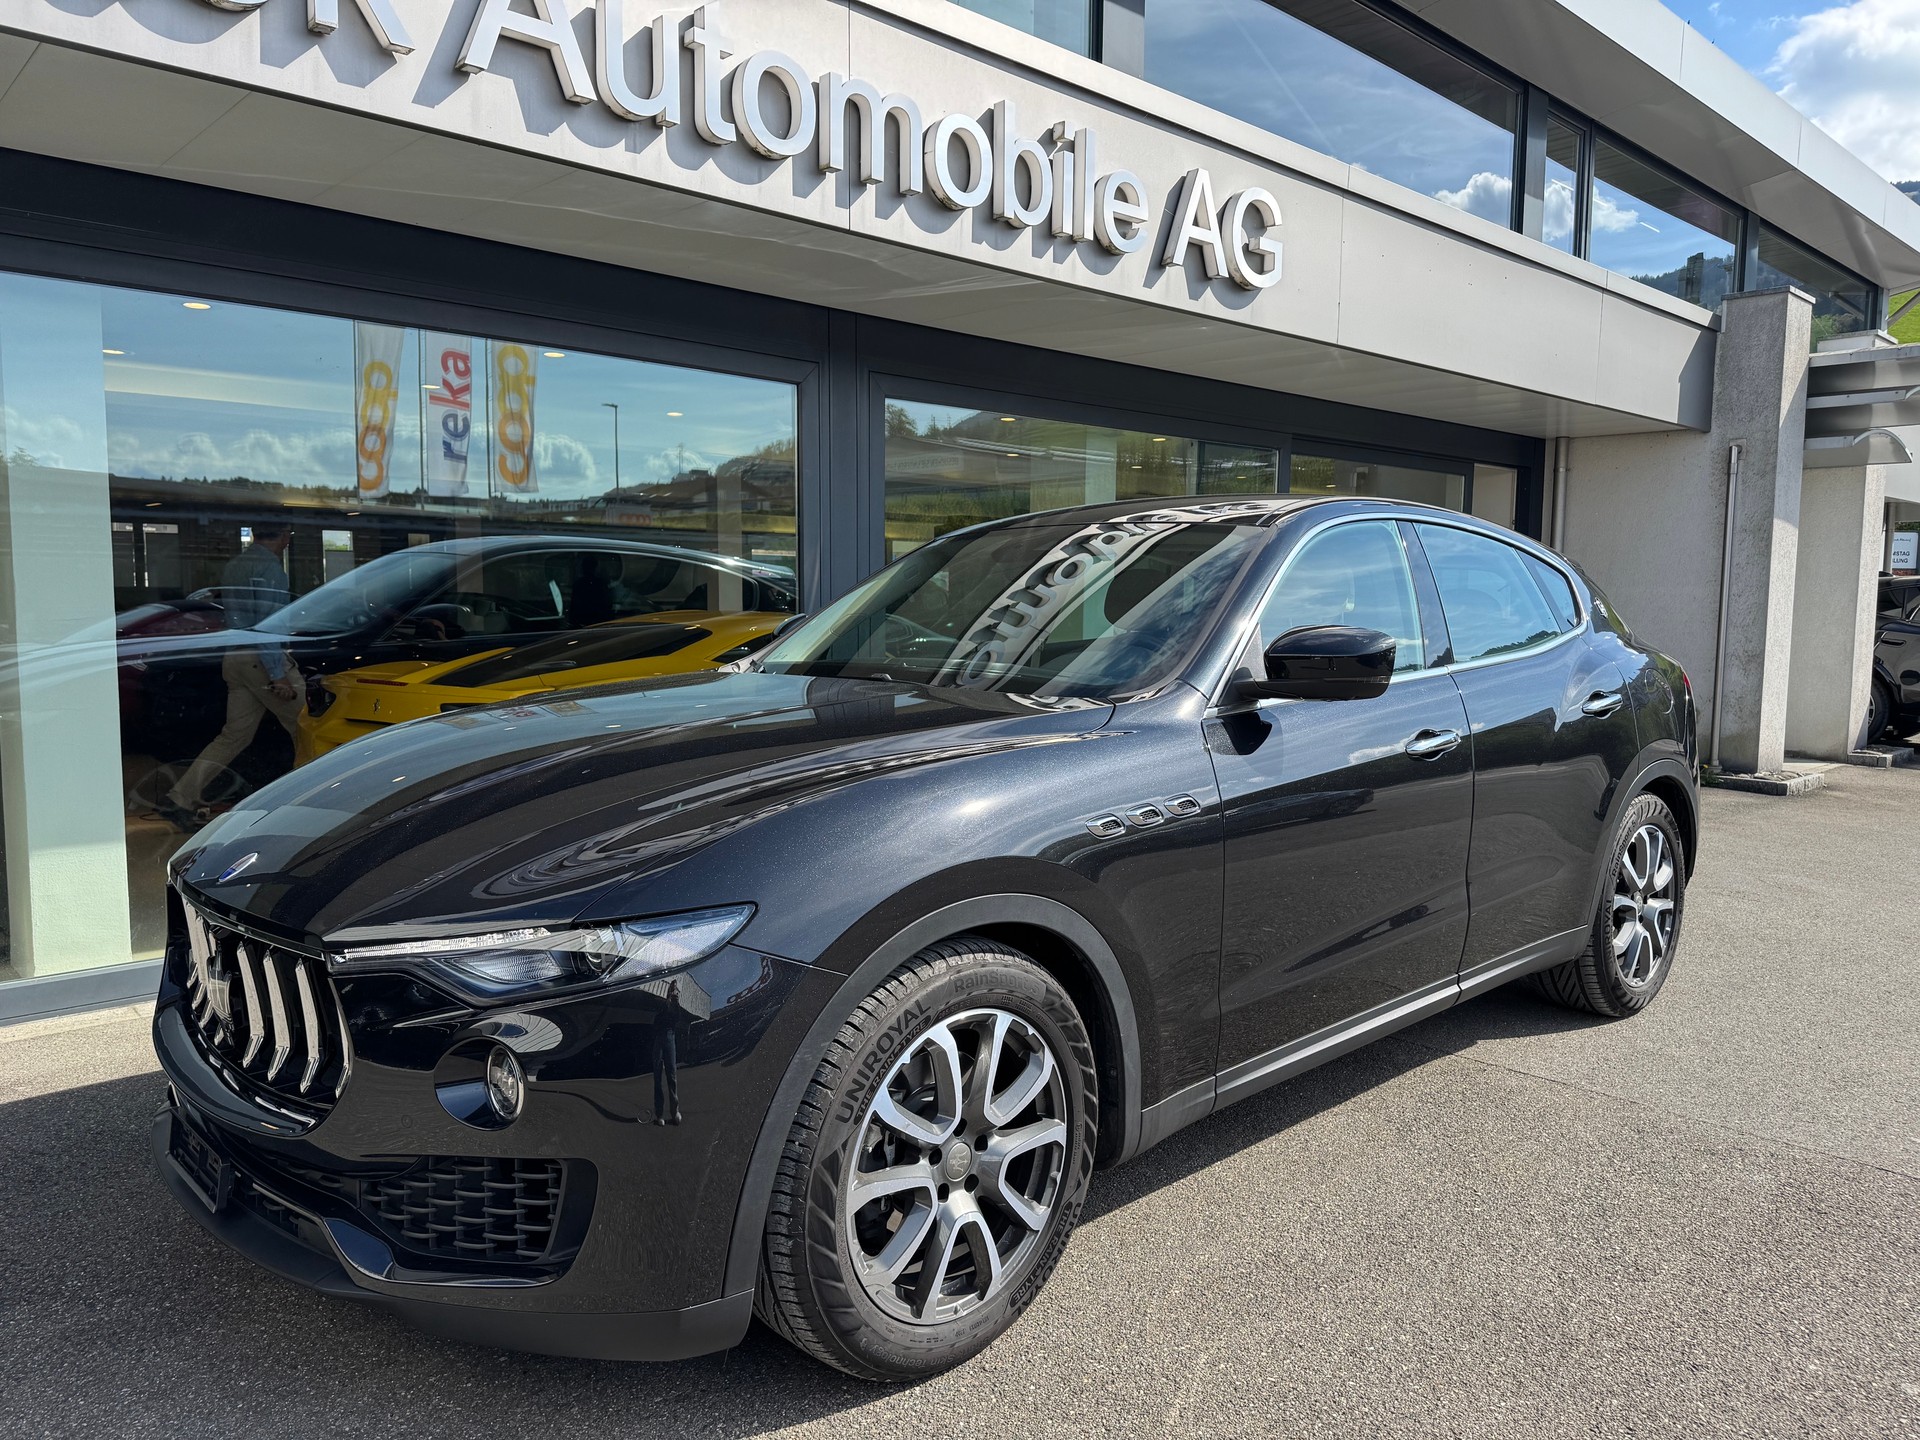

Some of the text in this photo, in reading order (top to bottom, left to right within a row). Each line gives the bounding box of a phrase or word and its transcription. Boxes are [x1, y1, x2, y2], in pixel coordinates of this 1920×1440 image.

[455, 0, 1284, 290] Automobile AG
[429, 347, 472, 465] reka
[497, 345, 536, 486] coop
[953, 970, 1029, 993] RainSport
[835, 999, 931, 1124] UNIROYAL
[856, 1021, 928, 1118] THE RAIN TYRE
[1013, 1208, 1071, 1304] THE RAIN TYRE
[870, 1342, 926, 1370] Technology
